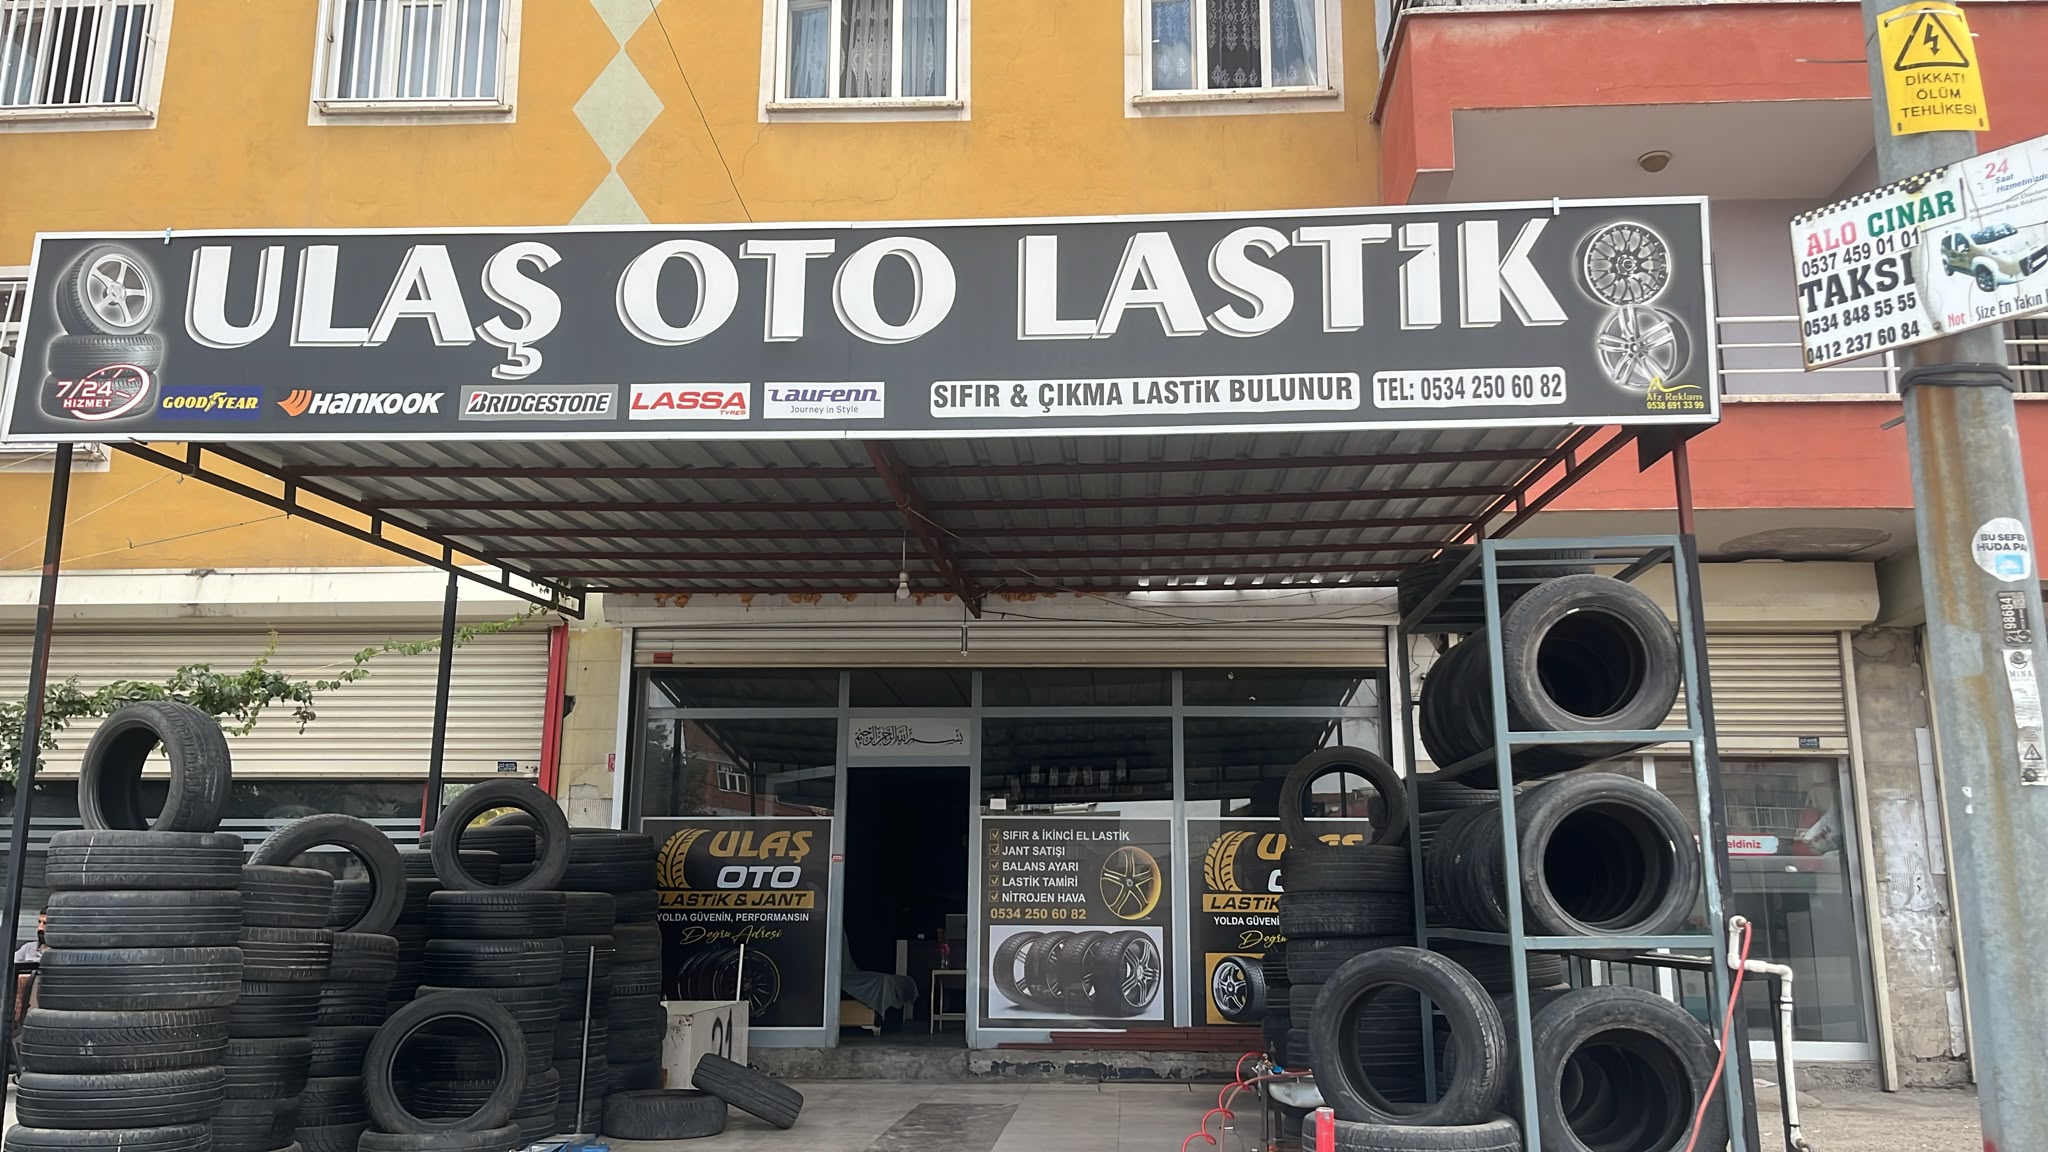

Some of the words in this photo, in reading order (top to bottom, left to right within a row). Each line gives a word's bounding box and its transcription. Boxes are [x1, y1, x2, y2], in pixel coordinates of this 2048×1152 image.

[1916, 87, 1961, 100] ÖLÜM
[1901, 102, 1977, 118] TEHLİKESİ
[1985, 157, 2009, 179] 24
[1995, 173, 2014, 184] Saat
[1807, 221, 1857, 257] ALO
[1802, 252, 1838, 278] 0537
[1842, 242, 1871, 265] 459
[1876, 235, 1895, 255] 01
[1901, 227, 1920, 248] 01
[185, 241, 562, 379] ULAŞ
[616, 236, 957, 346] OTO
[1804, 313, 1838, 337] 0534
[1843, 304, 1870, 326] 848
[1874, 298, 1894, 319] 55
[1898, 291, 1917, 312] 55
[1976, 305, 1997, 321] Size
[1998, 300, 2012, 314] En
[2013, 294, 2043, 310] Yakın
[1806, 341, 1842, 364] 0412
[1846, 333, 1873, 355] 237
[1878, 326, 1896, 346] 60
[1901, 320, 1920, 340] 84
[56, 379, 113, 398] 7/24
[933, 384, 1000, 408] SIFIR
[1010, 383, 1028, 408] &
[1038, 382, 1123, 413] ÇIKMA
[1229, 376, 1353, 403] BULUNUR
[1377, 377, 1415, 401] TEL:
[1420, 376, 1465, 400] 0534
[1471, 374, 1505, 399] 250
[1511, 374, 1533, 398] 60
[1540, 373, 1562, 397] 82
[467, 391, 610, 414] BRIDGESTONE
[631, 391, 747, 410] LASSA
[1665, 392, 1703, 401] Reklam
[790, 405, 824, 414] Journey
[826, 405, 834, 413] in
[836, 405, 858, 414] Style
[1647, 401, 1666, 409] 0538
[1682, 401, 1693, 409] 33
[1980, 533, 1996, 541] BU
[1002, 831, 1029, 840] SIFIR
[1032, 831, 1040, 840] &
[1042, 829, 1073, 841] İKİNCİ
[1076, 830, 1090, 840] EL
[1092, 829, 1130, 840] LASTİK
[709, 831, 813, 863] ULAŞ
[1002, 846, 1030, 856] JANT
[1032, 846, 1065, 858] SATIŞI
[1728, 840, 1761, 849] eldiniz
[1002, 862, 1046, 871] BALANS
[1048, 862, 1079, 871] AYARI
[716, 866, 801, 888] OTO
[1002, 876, 1040, 887] LASTİK
[1043, 876, 1078, 887] TAMİRİ
[733, 893, 748, 907] &
[751, 893, 807, 907] JANT
[1002, 891, 1054, 903] NİTROJEN
[1057, 893, 1086, 903] HAVA
[657, 912, 688, 922] YOLDA
[689, 911, 734, 924] GÜVENİN,
[735, 912, 809, 922] PERFORMANSIN
[990, 908, 1021, 919] 0534
[1024, 908, 1048, 919] 250
[1051, 908, 1067, 919] 60
[1071, 908, 1087, 919] 82
[1213, 916, 1245, 926] YOLDA
[1246, 915, 1280, 926] GÜVENİ
[731, 925, 782, 945] Adresi
